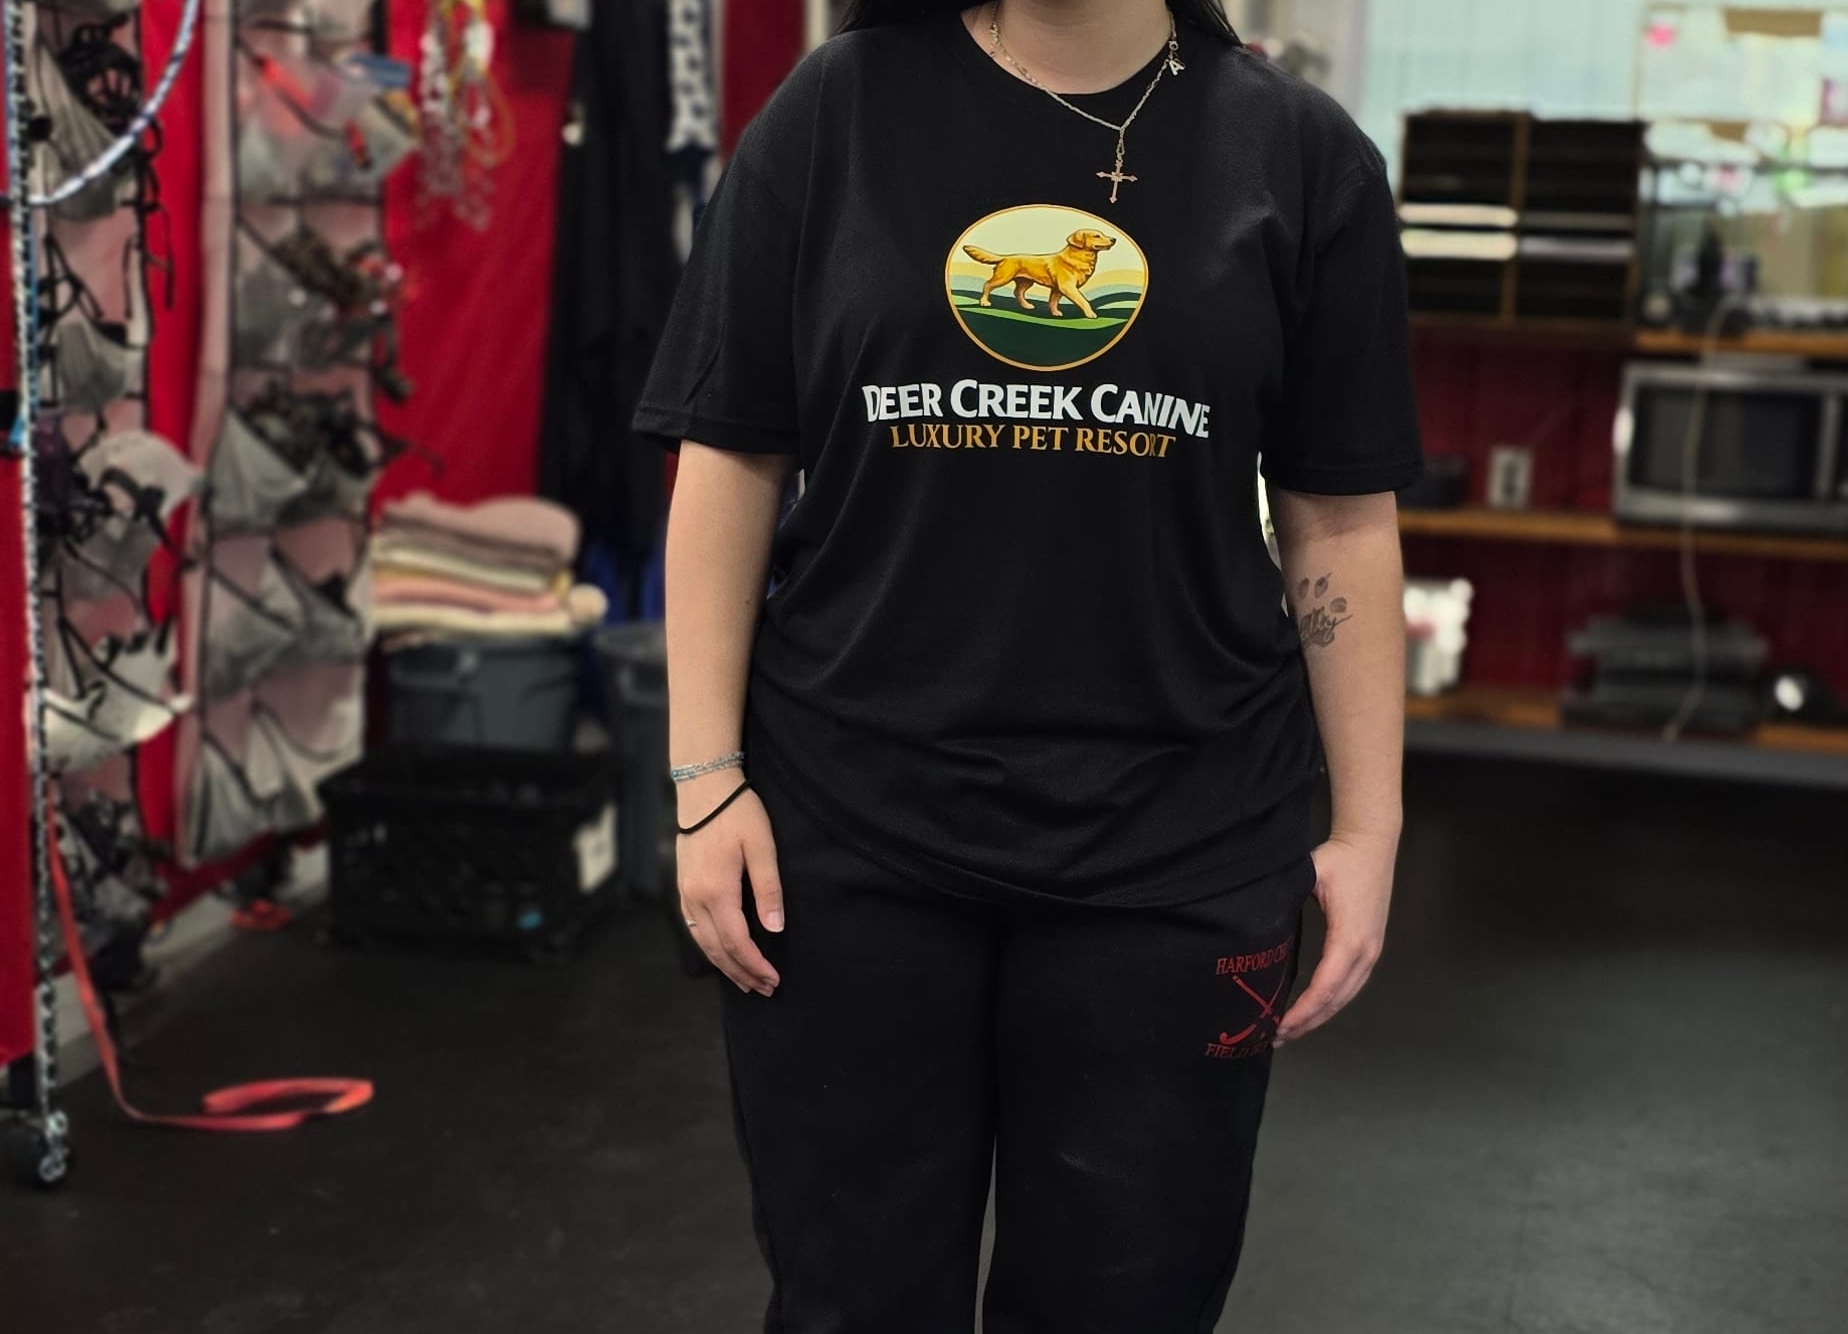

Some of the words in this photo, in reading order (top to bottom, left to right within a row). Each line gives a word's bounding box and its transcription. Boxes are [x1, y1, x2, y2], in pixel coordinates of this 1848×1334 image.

[862, 383, 944, 423] DEER
[950, 378, 1084, 421] CREEK
[1090, 383, 1211, 439] CANINE
[890, 424, 1006, 450] LUXURY
[1012, 426, 1069, 451] PET
[1216, 948, 1274, 976] HARFORD
